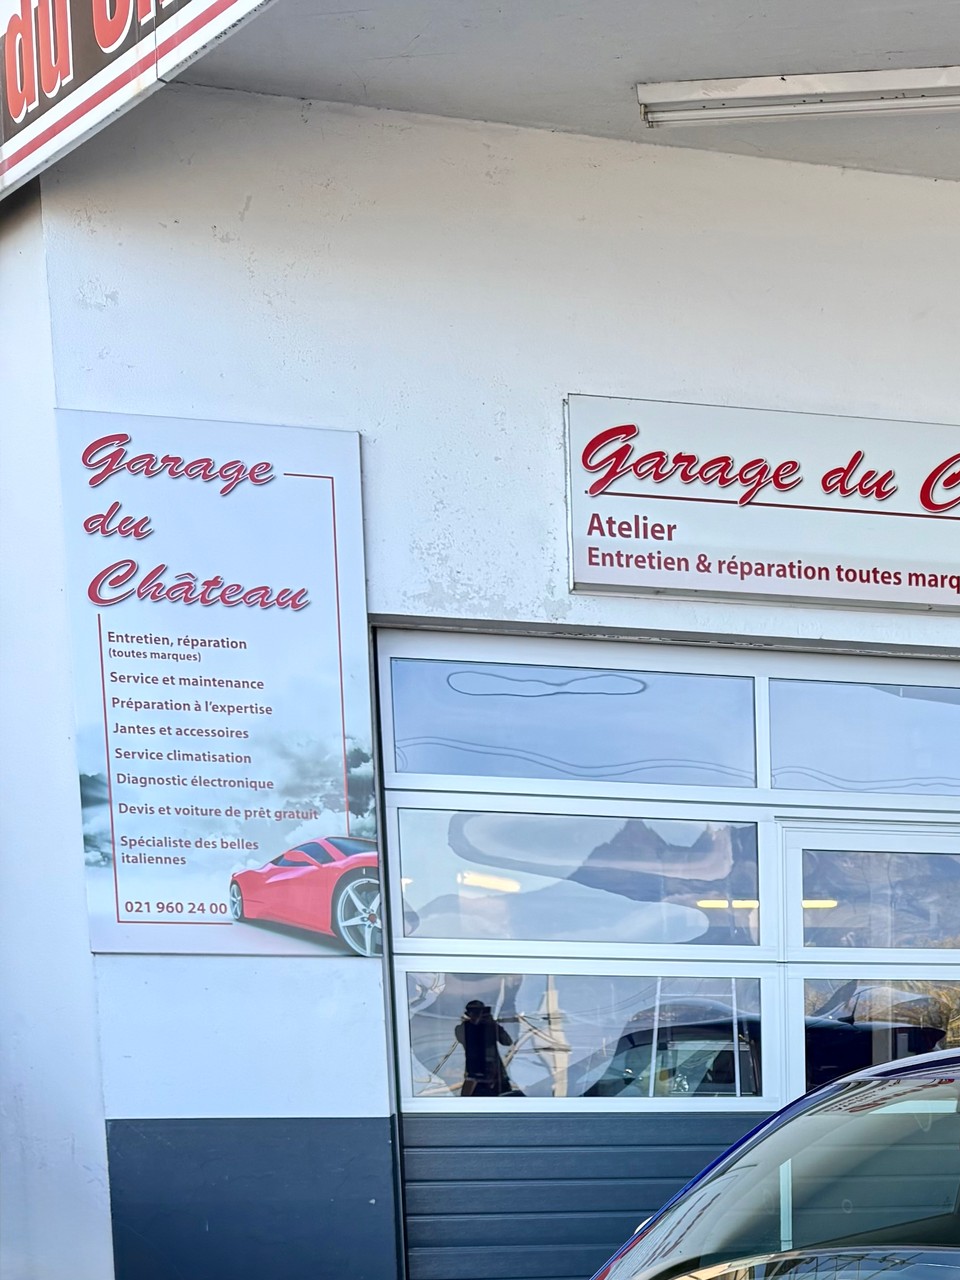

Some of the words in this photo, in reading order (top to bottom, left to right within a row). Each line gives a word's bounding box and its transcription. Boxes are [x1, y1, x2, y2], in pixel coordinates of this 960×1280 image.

[80, 432, 277, 497] Garage
[580, 422, 803, 508] Garage
[820, 449, 898, 502] du
[82, 500, 155, 540] du
[586, 513, 678, 542] Atelier
[586, 546, 691, 573] Entretien
[695, 553, 713, 574] &
[717, 555, 830, 582] réparation
[836, 562, 903, 587] toutes
[86, 558, 312, 612] Château
[107, 631, 175, 648] Entretien,
[177, 635, 248, 651] réparation
[108, 648, 148, 661] (toutes
[150, 651, 202, 663] marques)
[109, 671, 160, 686] Service
[162, 675, 176, 687] et
[178, 676, 265, 690] maintenance
[111, 696, 191, 713] Préparation
[193, 698, 202, 713] à
[112, 722, 156, 736] Jantes
[159, 726, 173, 738] et
[175, 725, 250, 739] accessoires
[114, 747, 164, 761] Service
[166, 749, 252, 764] climatisation
[116, 772, 188, 788] Diagnostic
[190, 774, 275, 791] électronique
[118, 802, 156, 816] Devis
[158, 805, 171, 817] et
[174, 804, 221, 818] voiture
[224, 805, 242, 818] de
[244, 806, 272, 822] prêt
[274, 807, 319, 822] gratuit
[120, 835, 192, 852] Spécialiste
[194, 836, 217, 850] des
[220, 837, 259, 851] belles
[121, 852, 187, 866] italiennes
[124, 900, 152, 914] 021
[155, 901, 184, 915] 960
[187, 902, 206, 915] 24
[208, 902, 228, 915] 00
